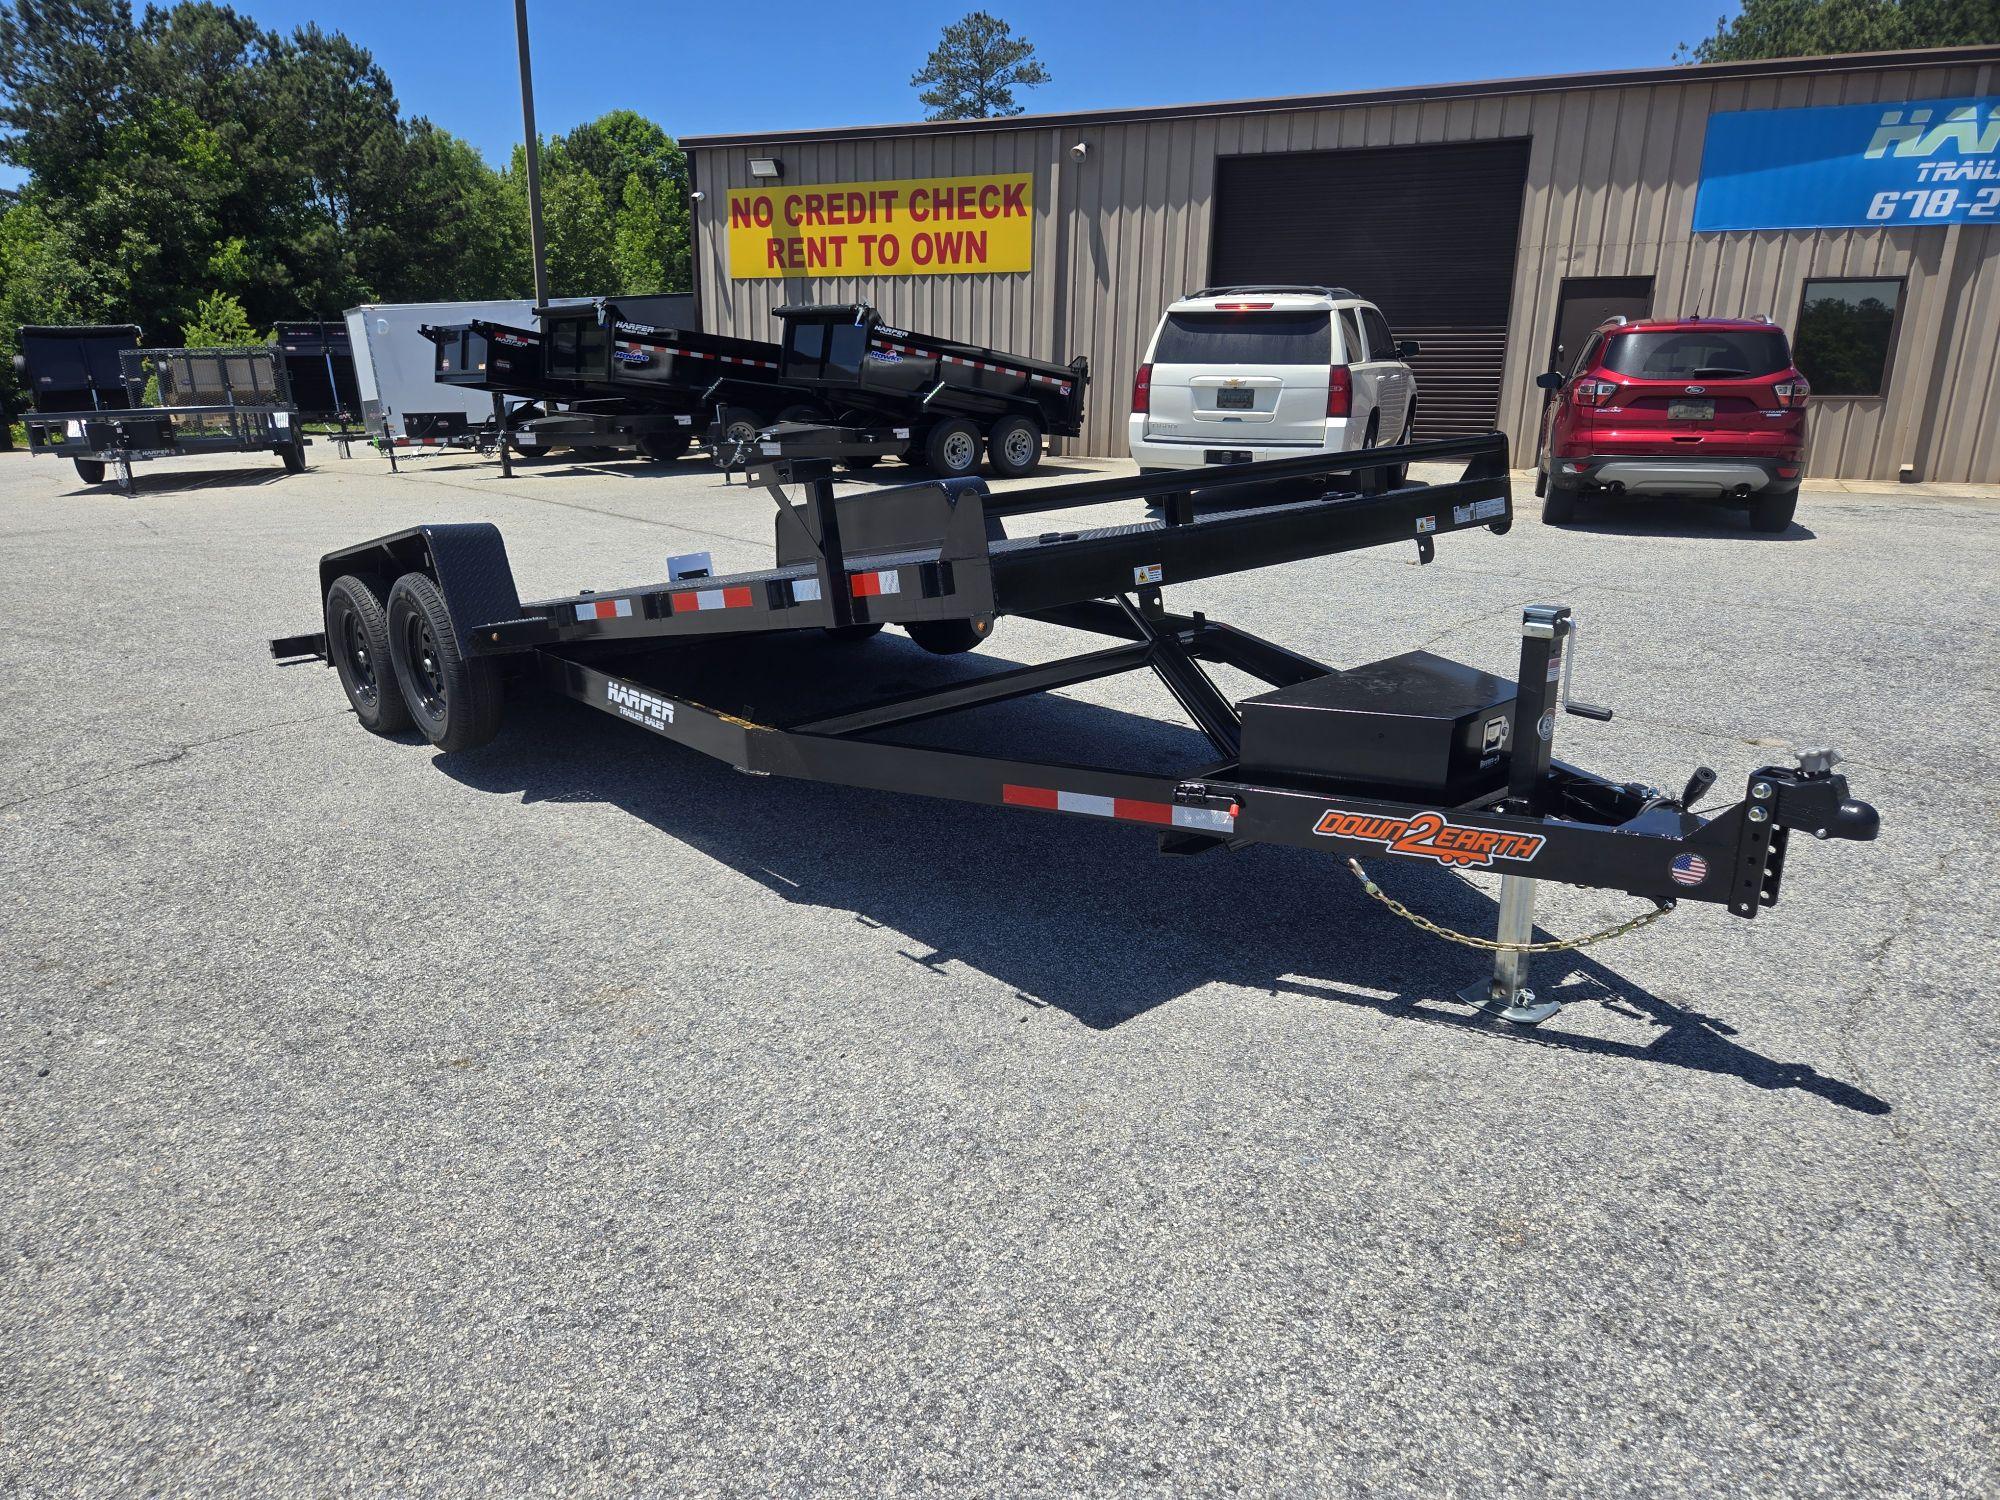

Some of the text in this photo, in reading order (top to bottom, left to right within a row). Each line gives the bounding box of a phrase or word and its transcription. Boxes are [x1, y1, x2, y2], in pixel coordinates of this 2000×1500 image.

[1864, 106, 2000, 159] HA
[1916, 160, 2000, 183] TRAIL
[731, 182, 1028, 229] NO CREDIT CHECK
[1866, 187, 2000, 220] 678-2
[767, 230, 988, 269] RENT TO OWN
[615, 320, 656, 333] HARPER
[874, 325, 909, 337] HARPER
[614, 350, 650, 362] Hawke
[870, 350, 904, 364] Hawke
[607, 681, 674, 723] HARPER
[618, 705, 665, 731] TRAILER SALES
